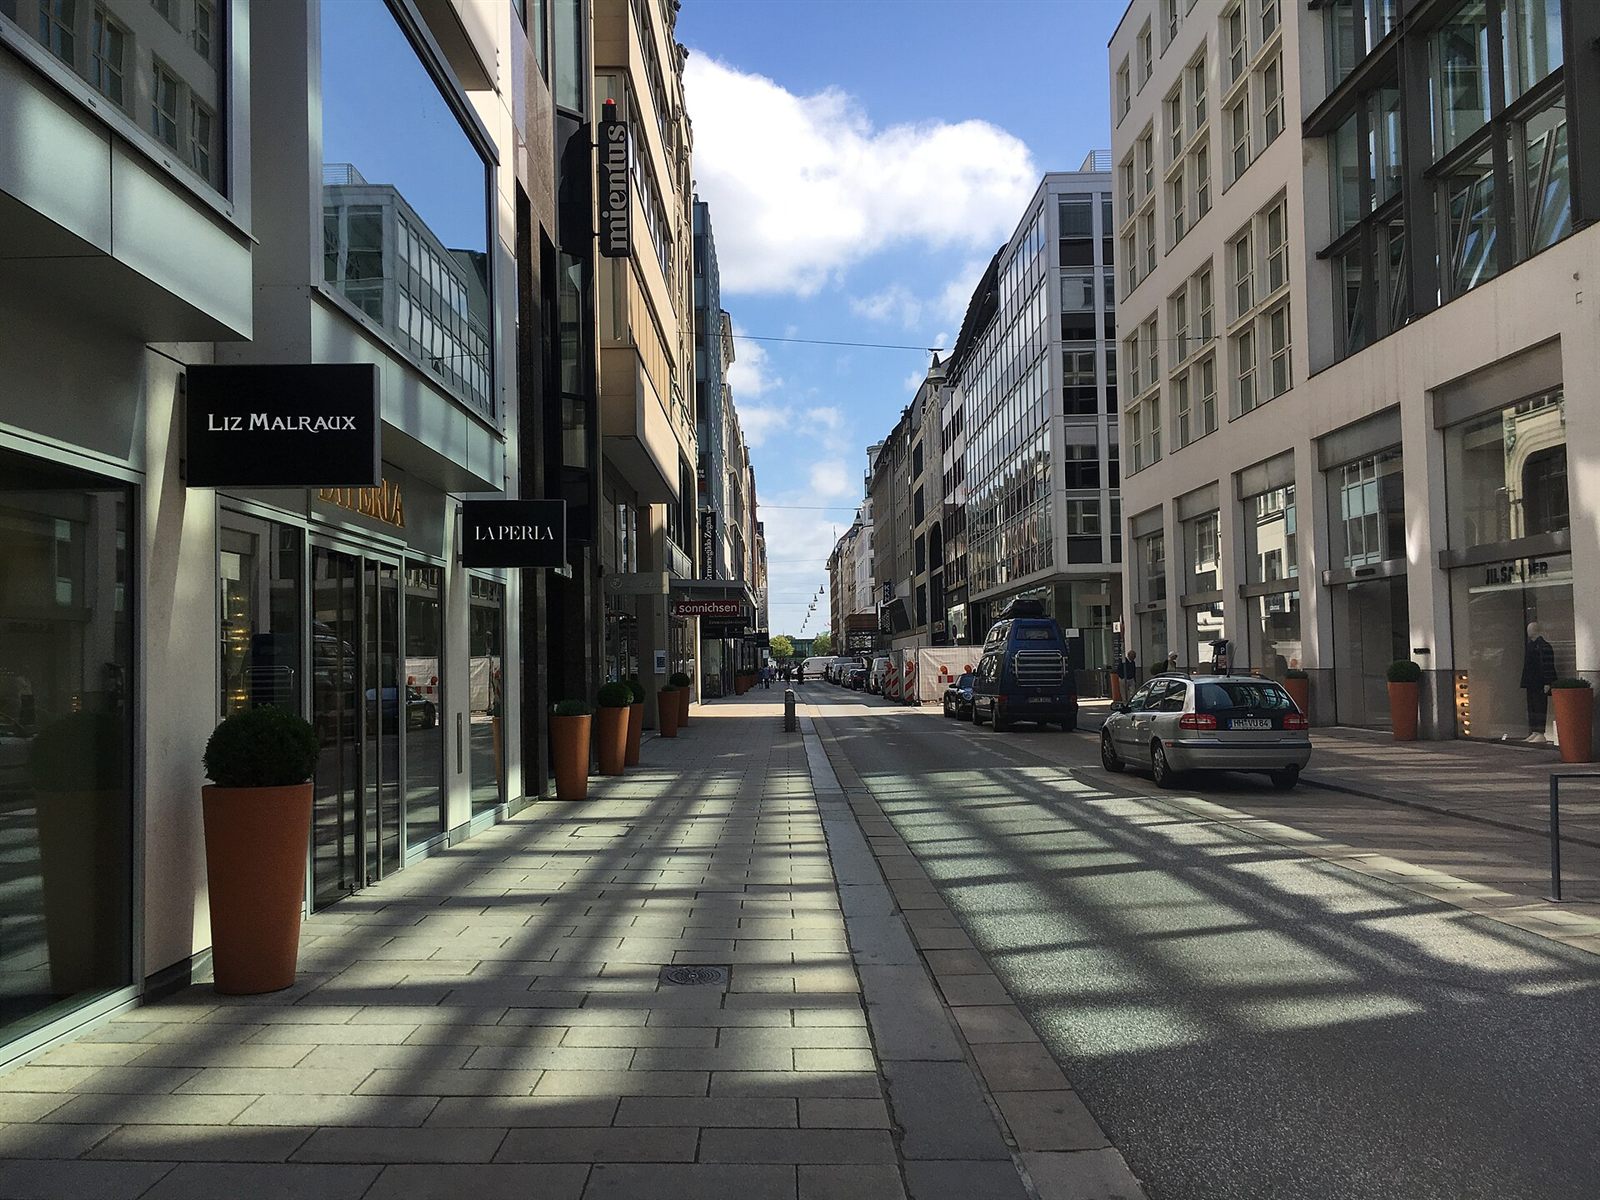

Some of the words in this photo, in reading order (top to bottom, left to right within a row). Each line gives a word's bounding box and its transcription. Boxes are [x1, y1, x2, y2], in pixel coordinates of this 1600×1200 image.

[602, 125, 628, 250] mientus
[475, 526, 498, 542] LA
[499, 526, 554, 542] PERLA
[704, 516, 714, 538] Zegna
[1486, 568, 1499, 585] JIL
[679, 602, 738, 613] sonnichsen
